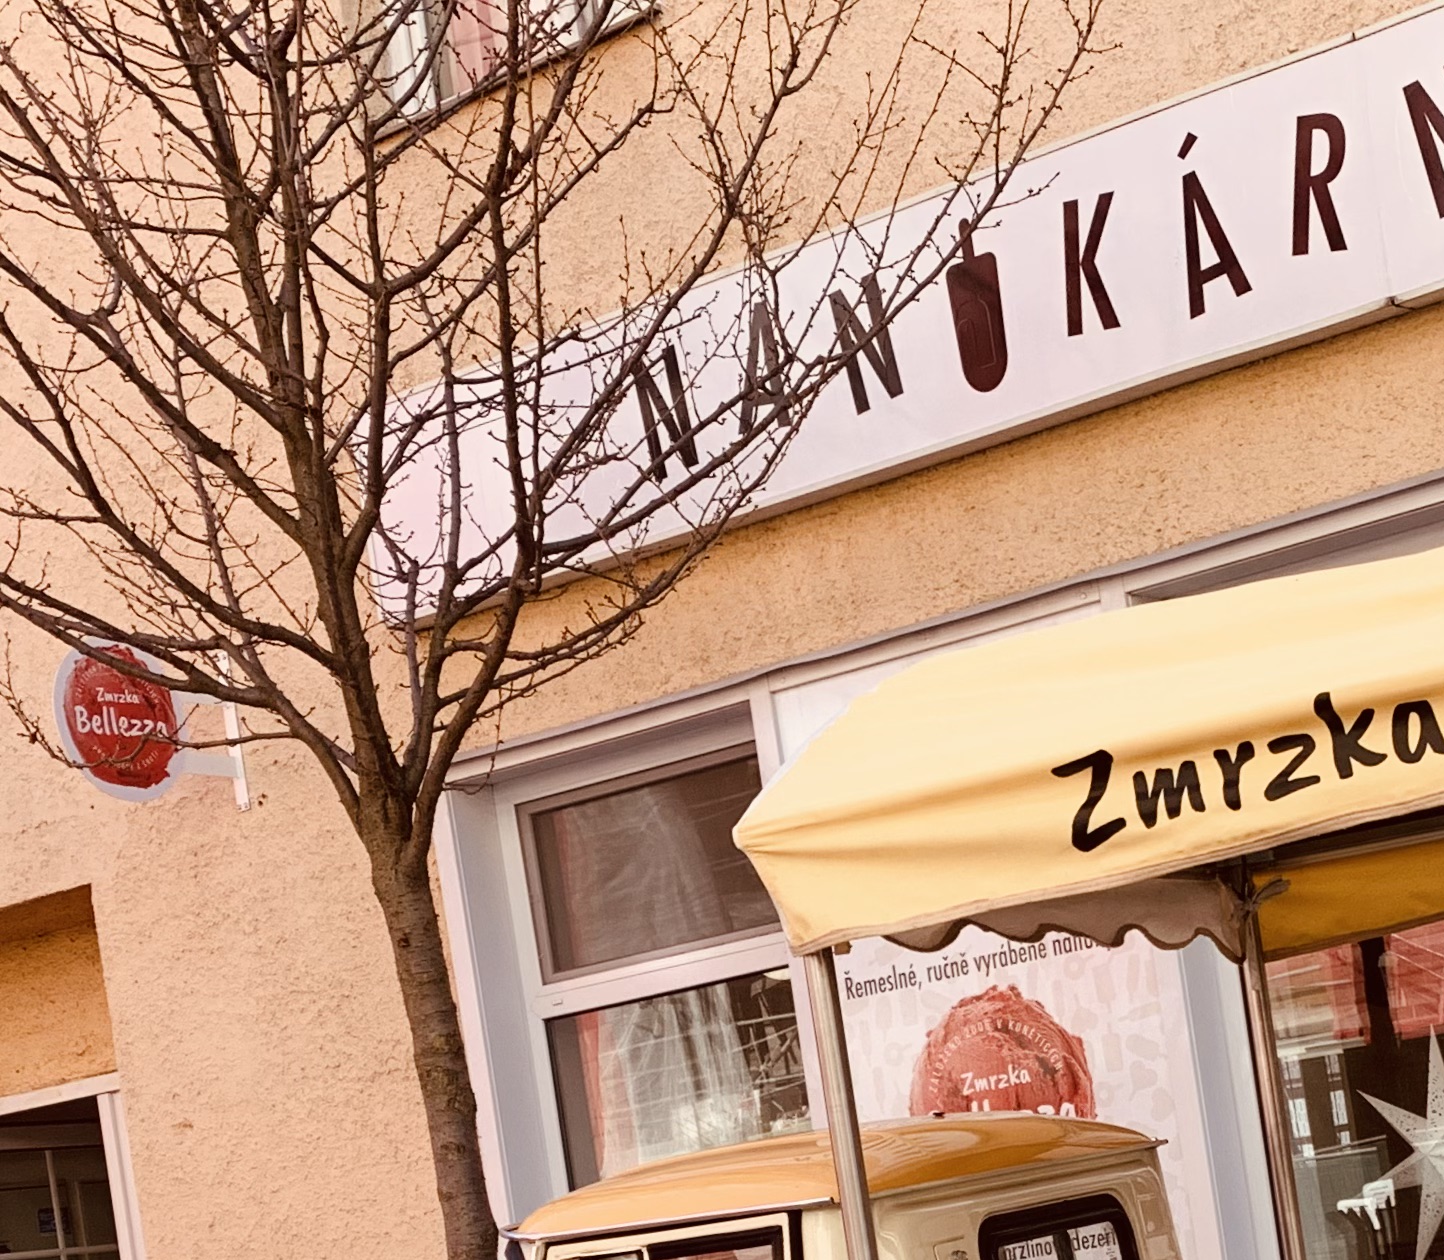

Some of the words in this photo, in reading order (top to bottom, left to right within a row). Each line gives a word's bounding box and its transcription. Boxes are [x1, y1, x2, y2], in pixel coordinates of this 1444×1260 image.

[95, 686, 140, 704] Zmrzka
[74, 705, 169, 738] Bellezza
[844, 963, 922, 1000] Řemeslné,
[926, 952, 969, 983] ručně
[960, 1063, 1032, 1096] Zmrzka
